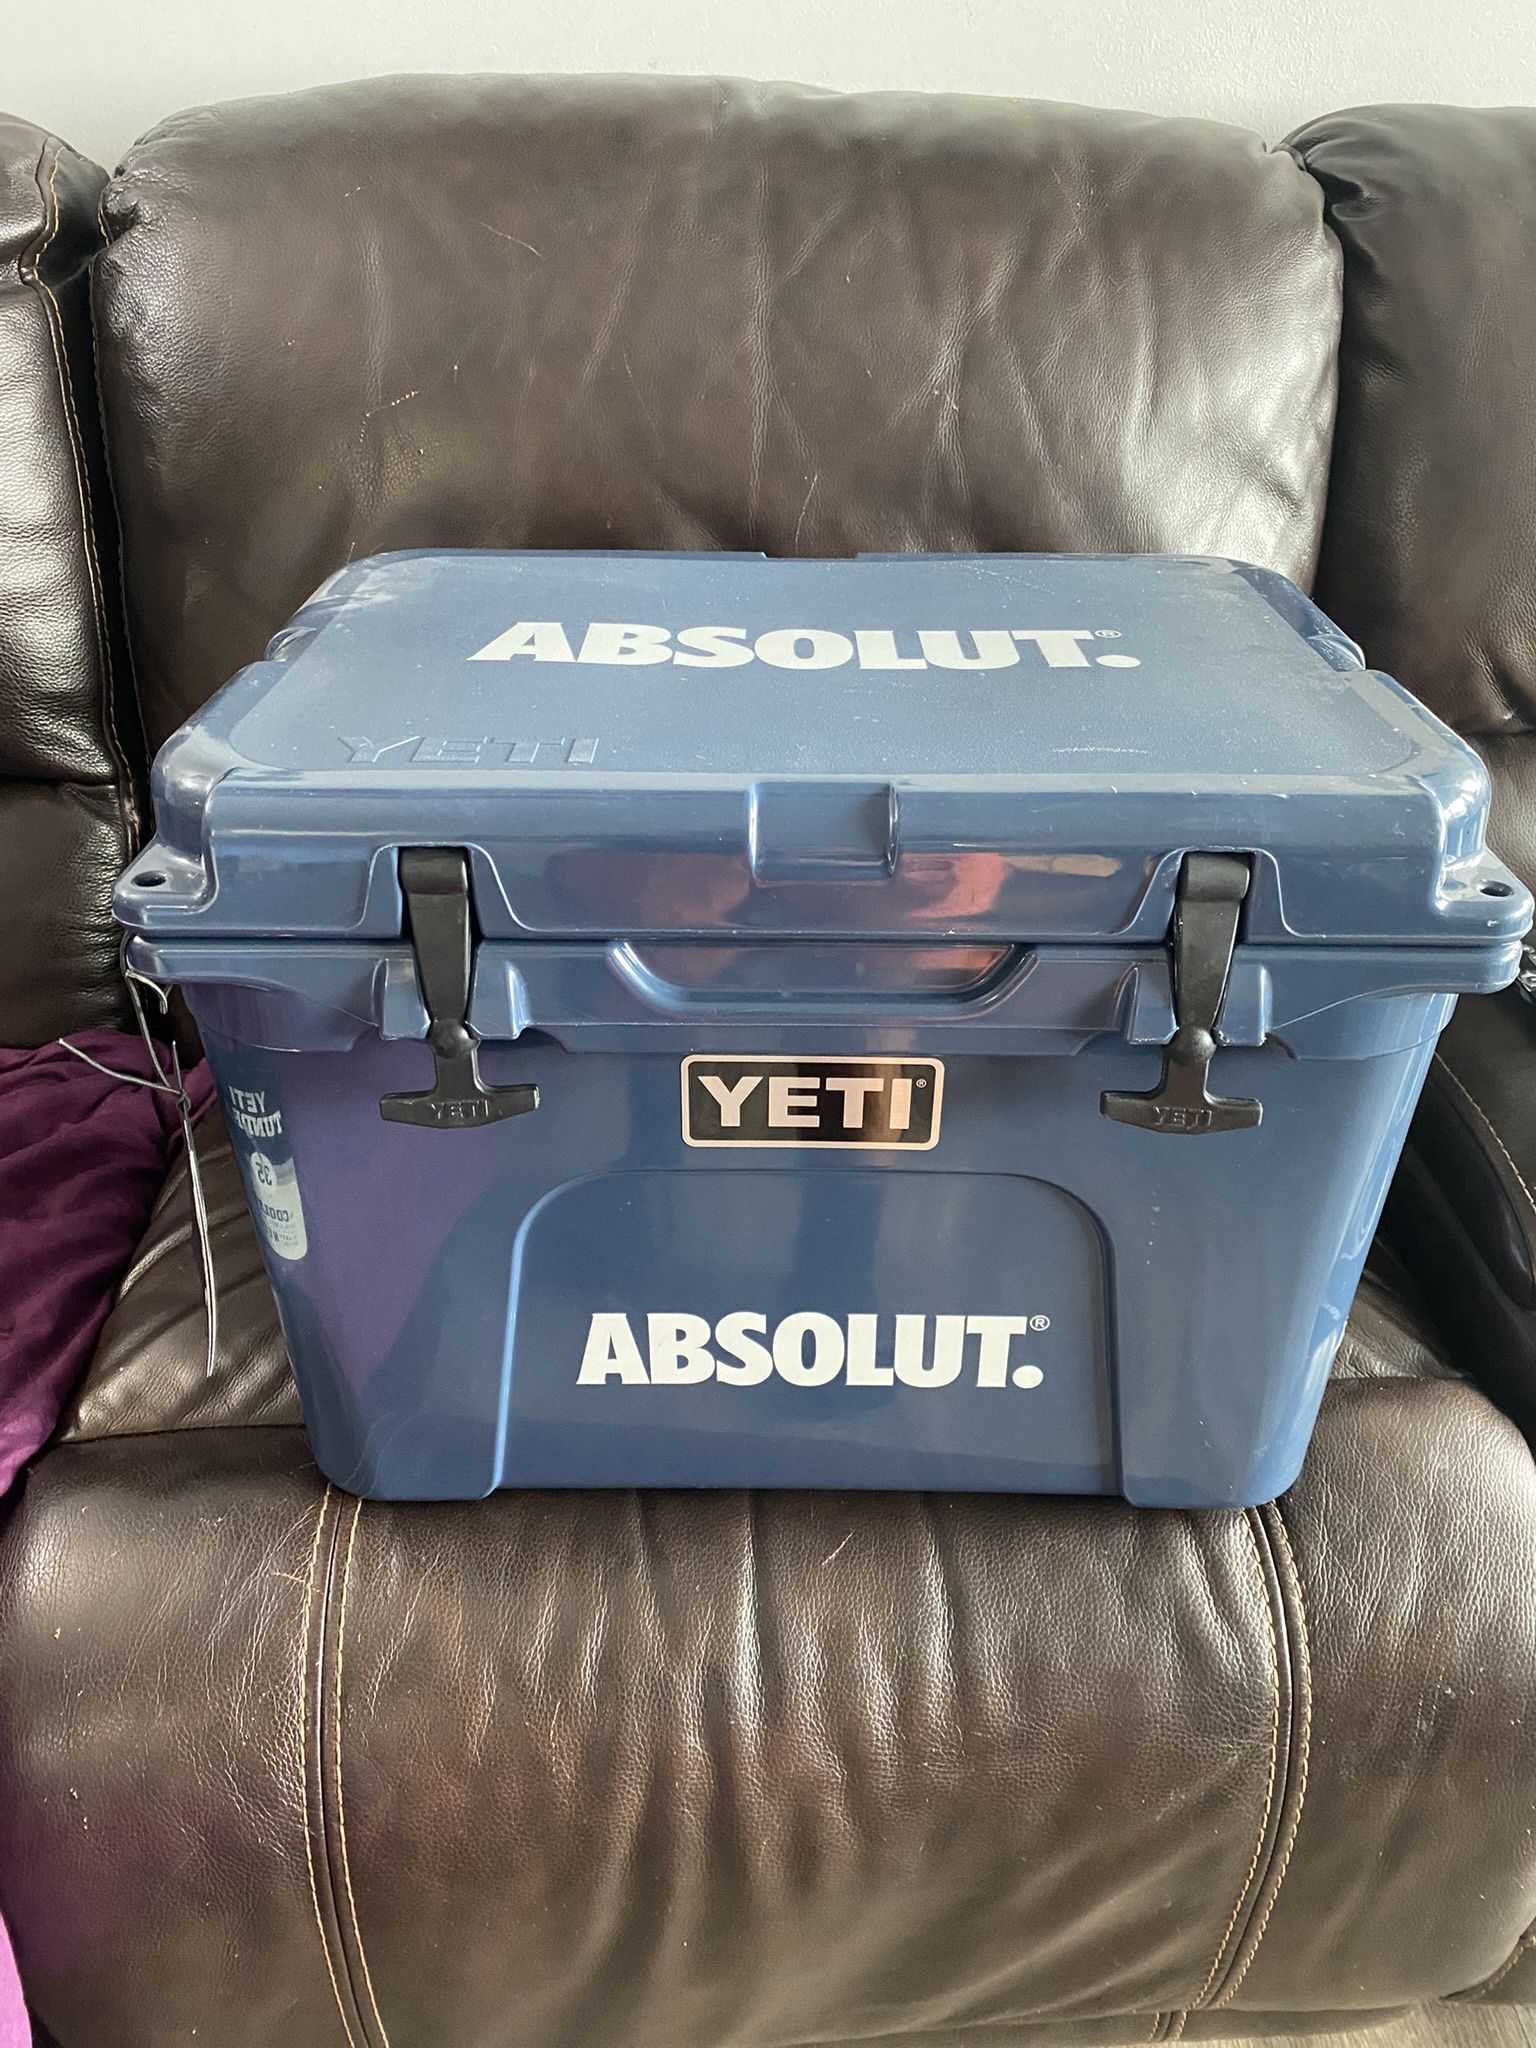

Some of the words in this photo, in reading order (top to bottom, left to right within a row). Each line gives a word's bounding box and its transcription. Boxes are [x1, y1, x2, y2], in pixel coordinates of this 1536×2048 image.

[337, 736, 600, 764] YETI
[431, 1100, 490, 1120] YETI
[697, 1075, 913, 1130] YETI
[1152, 1106, 1213, 1129] YETI
